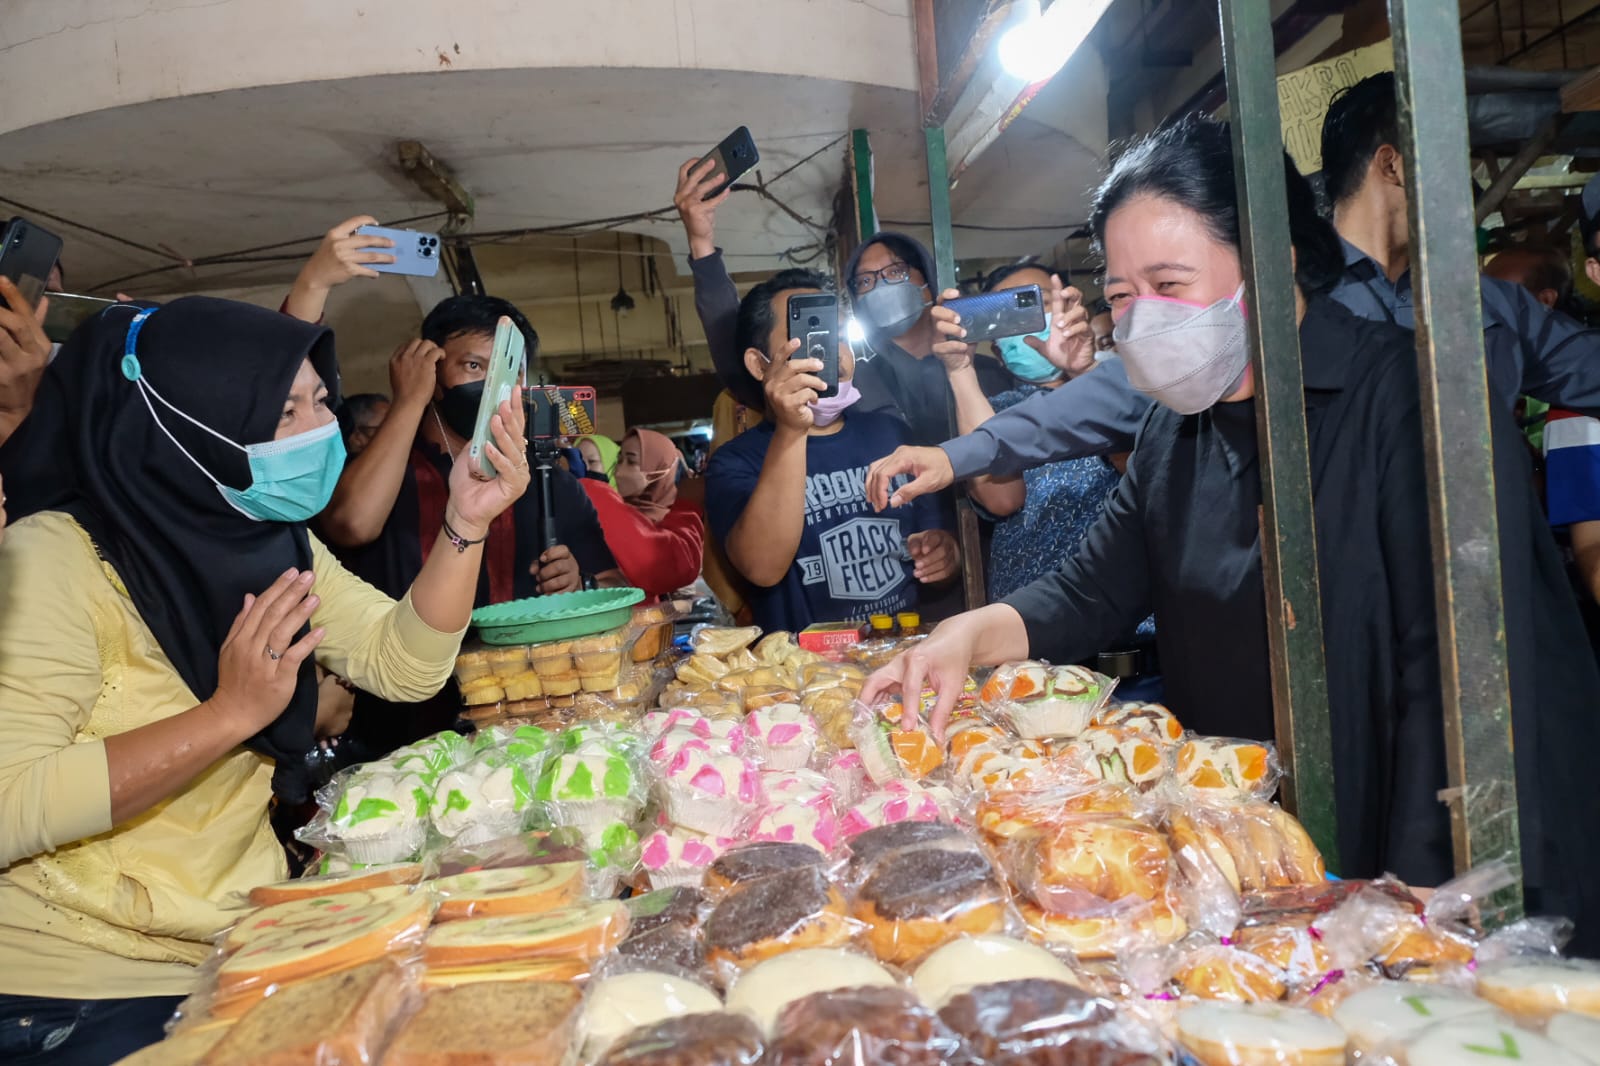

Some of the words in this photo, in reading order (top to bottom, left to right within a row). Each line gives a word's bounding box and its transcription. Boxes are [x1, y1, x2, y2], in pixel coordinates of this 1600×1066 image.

[826, 524, 898, 564] TRACK
[806, 562, 822, 577] 19
[841, 555, 896, 593] FIELD
